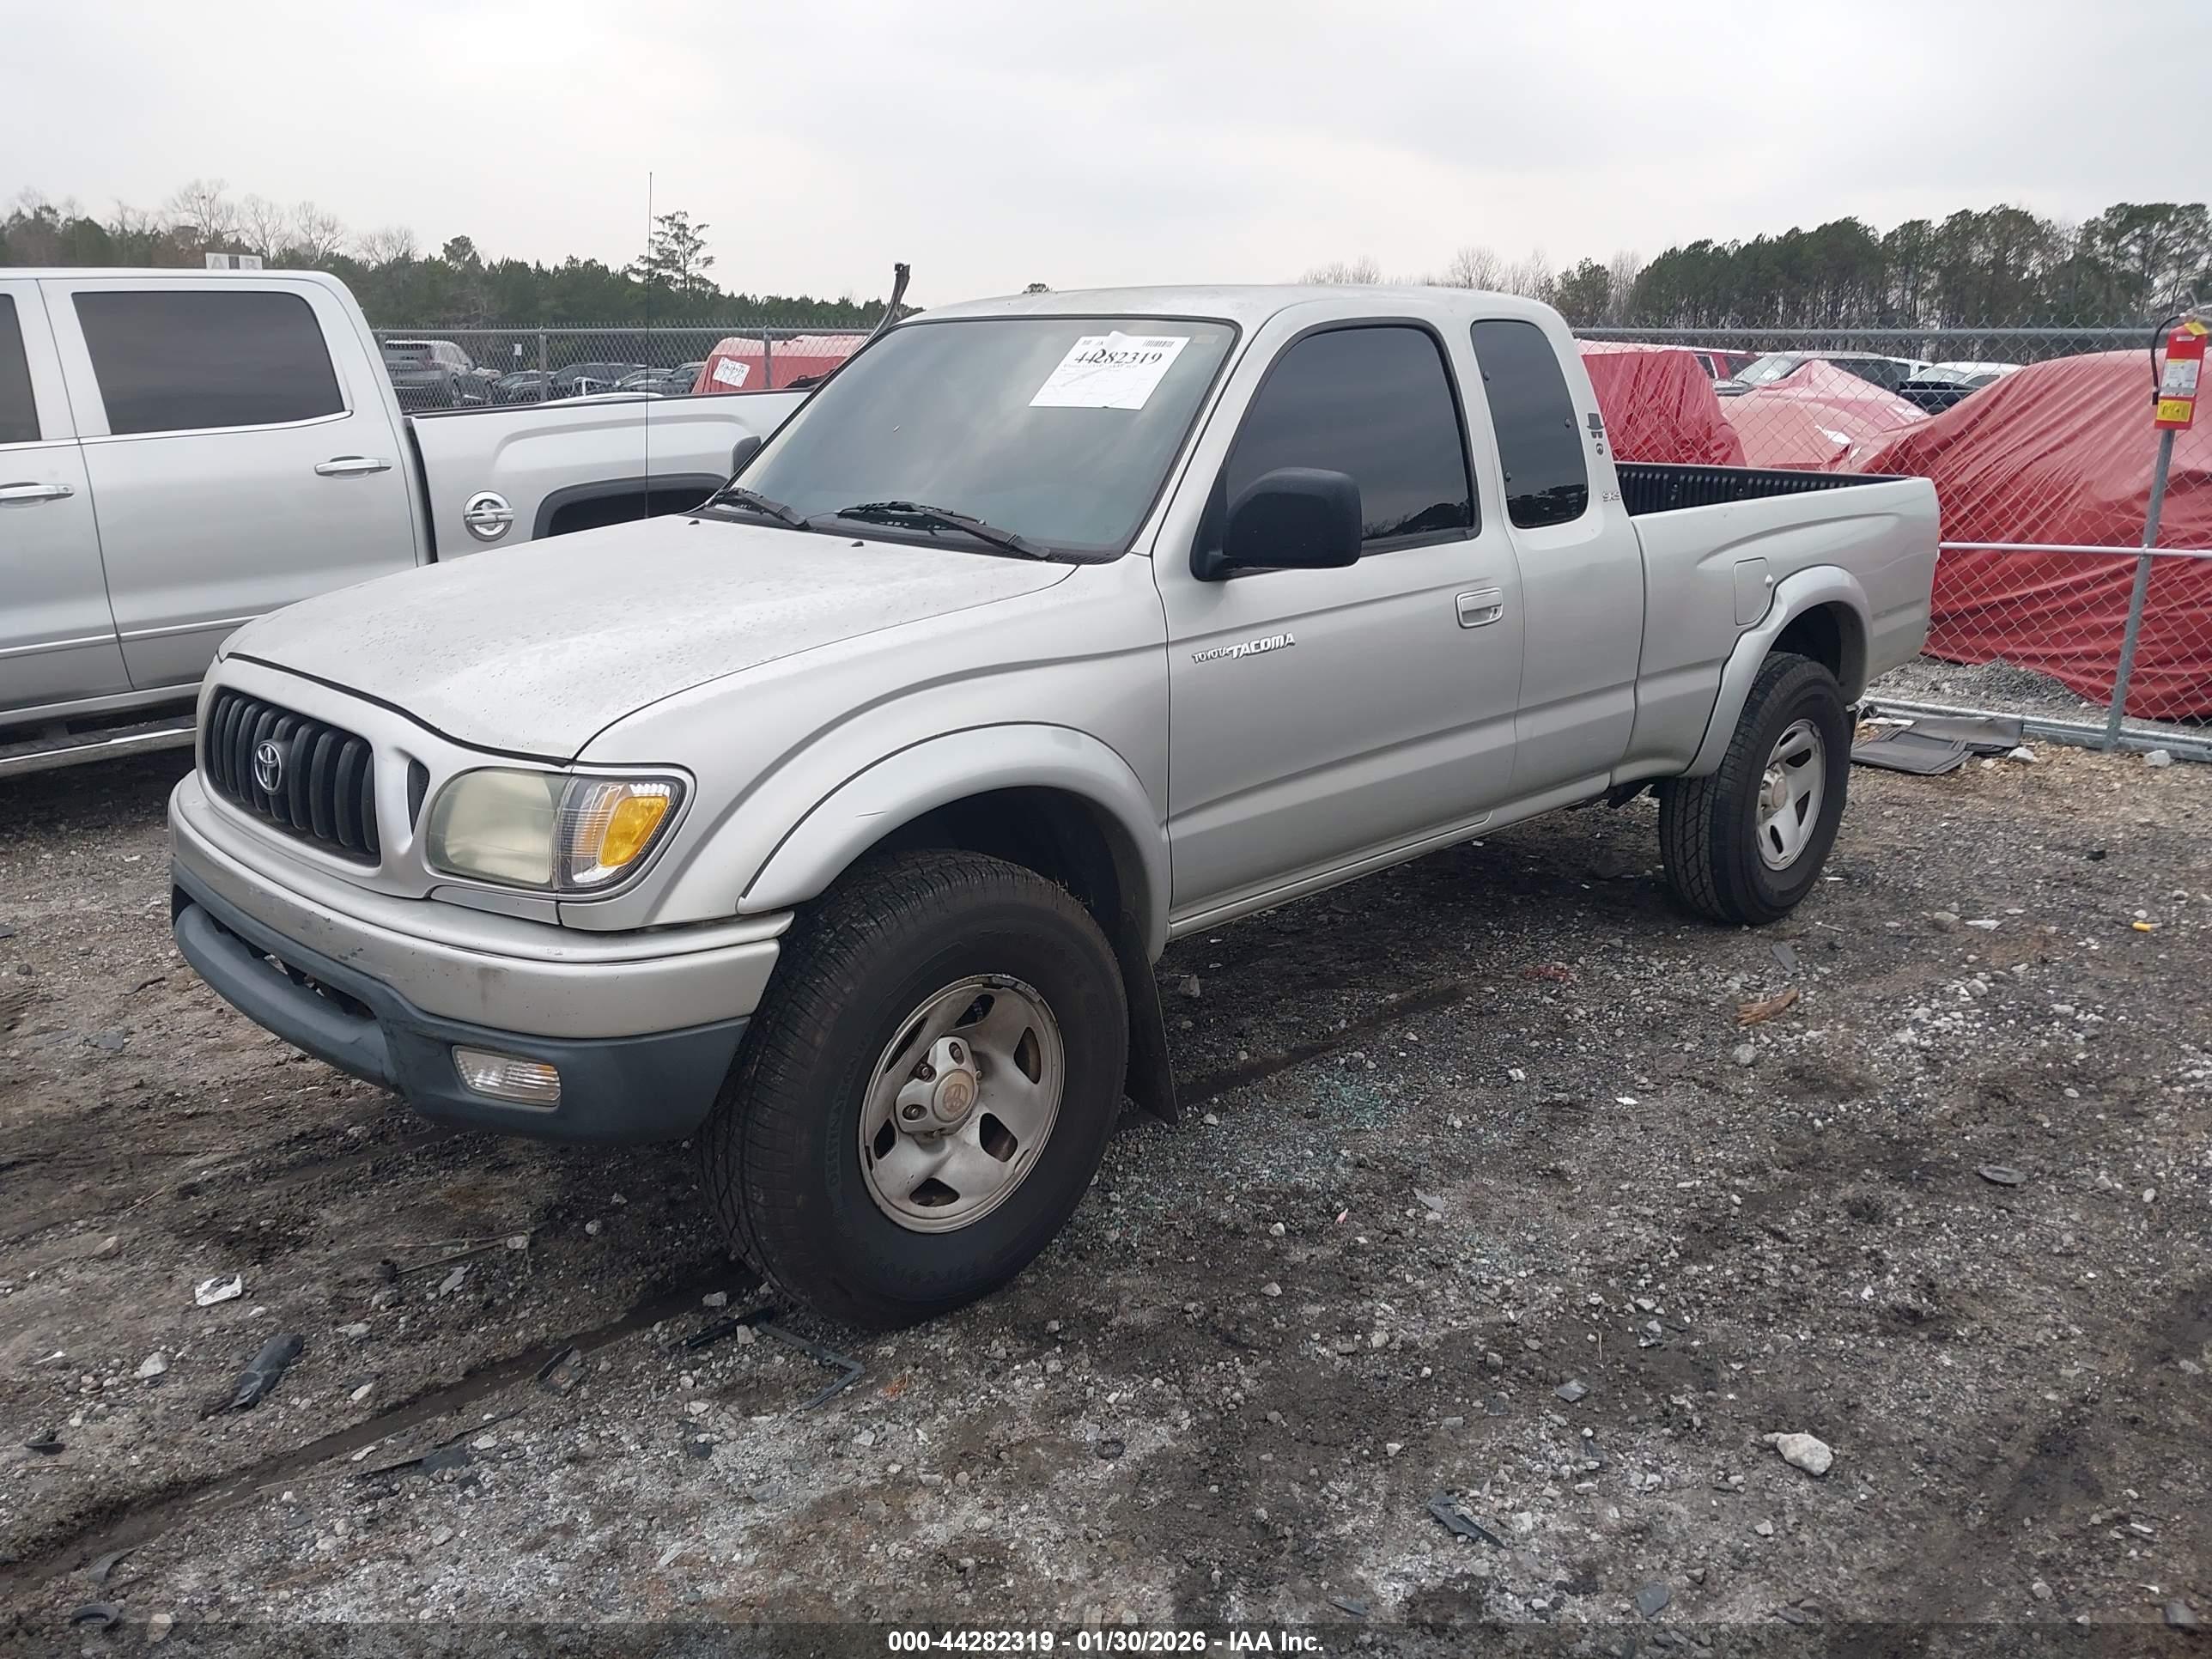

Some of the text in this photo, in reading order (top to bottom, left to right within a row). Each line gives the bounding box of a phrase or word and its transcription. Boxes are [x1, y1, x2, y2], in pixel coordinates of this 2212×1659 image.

[1074, 349, 1163, 364] 44282319
[1193, 632, 1296, 663] TOYOTA TACOMA
